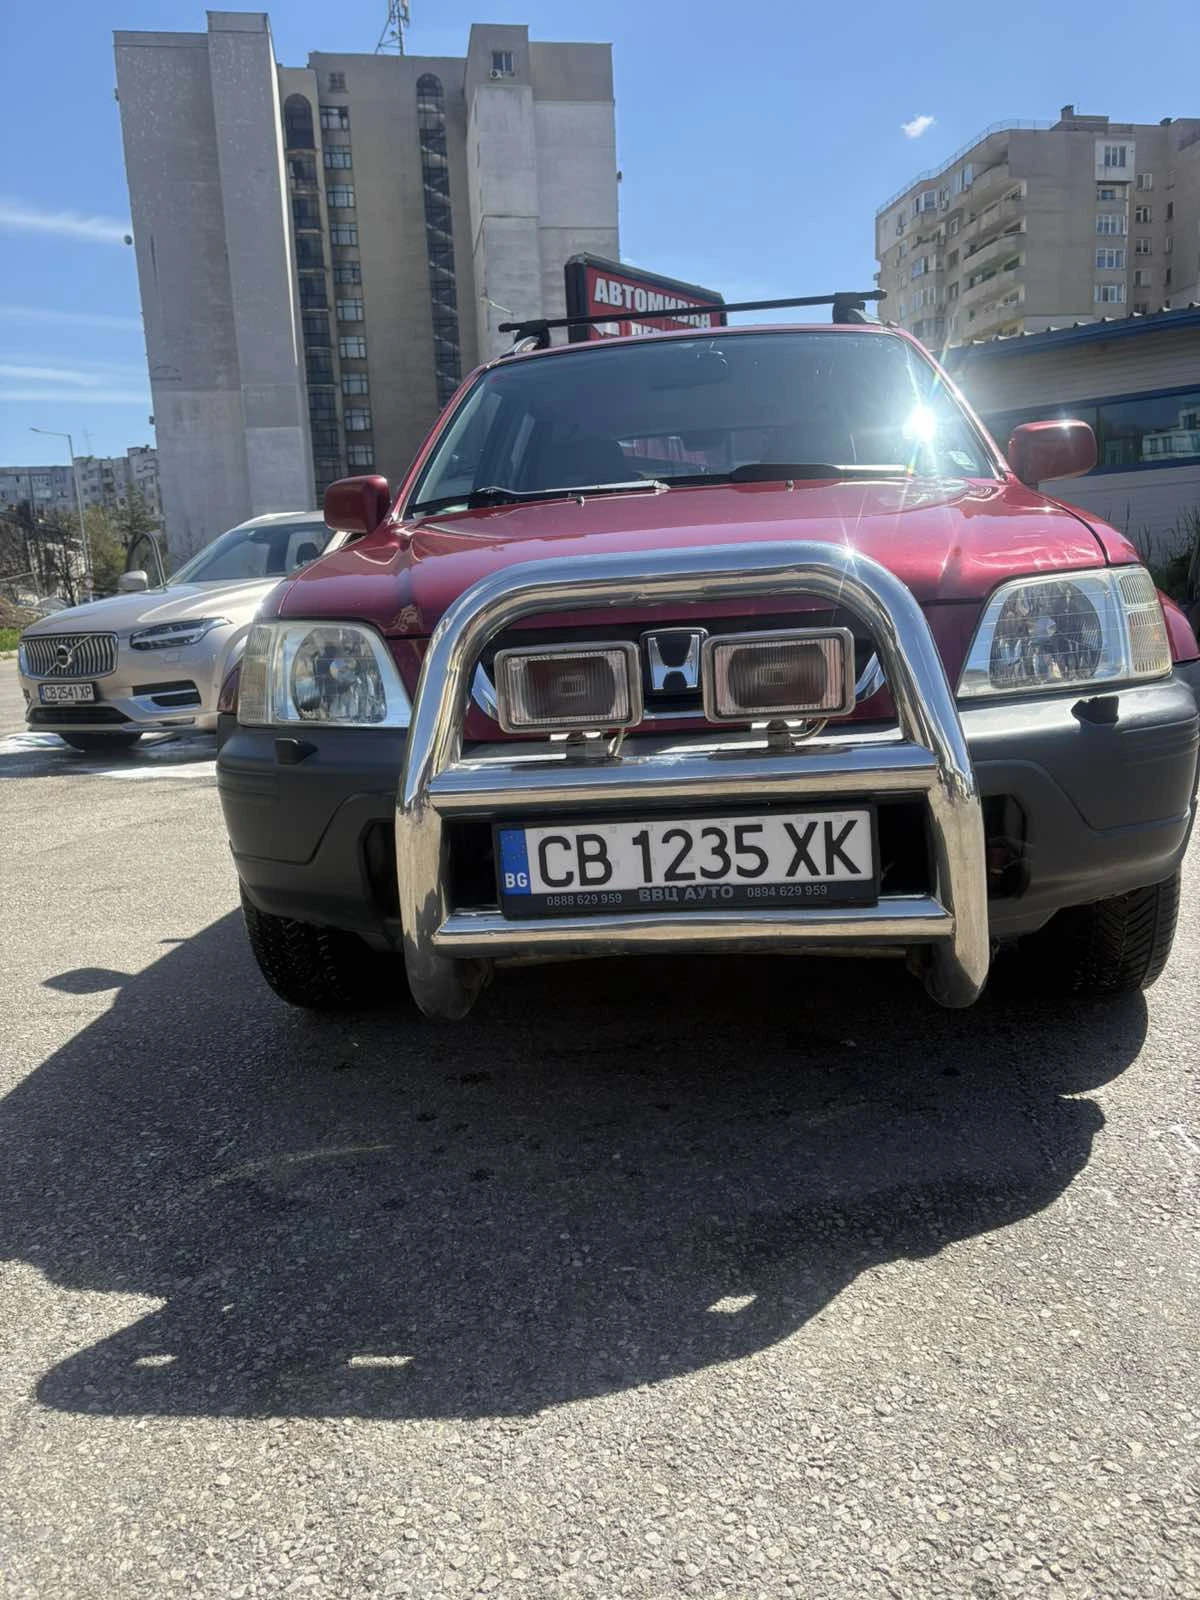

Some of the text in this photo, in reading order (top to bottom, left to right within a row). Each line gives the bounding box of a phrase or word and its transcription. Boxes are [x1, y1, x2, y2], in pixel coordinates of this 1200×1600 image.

[538, 820, 862, 888] CB 1235 XK
[504, 872, 528, 888] BG
[547, 895, 574, 906] 0888
[577, 894, 598, 905] 629
[600, 893, 622, 904] 959
[747, 886, 776, 898] 0894
[780, 885, 802, 897] 629
[805, 885, 828, 896] 959
